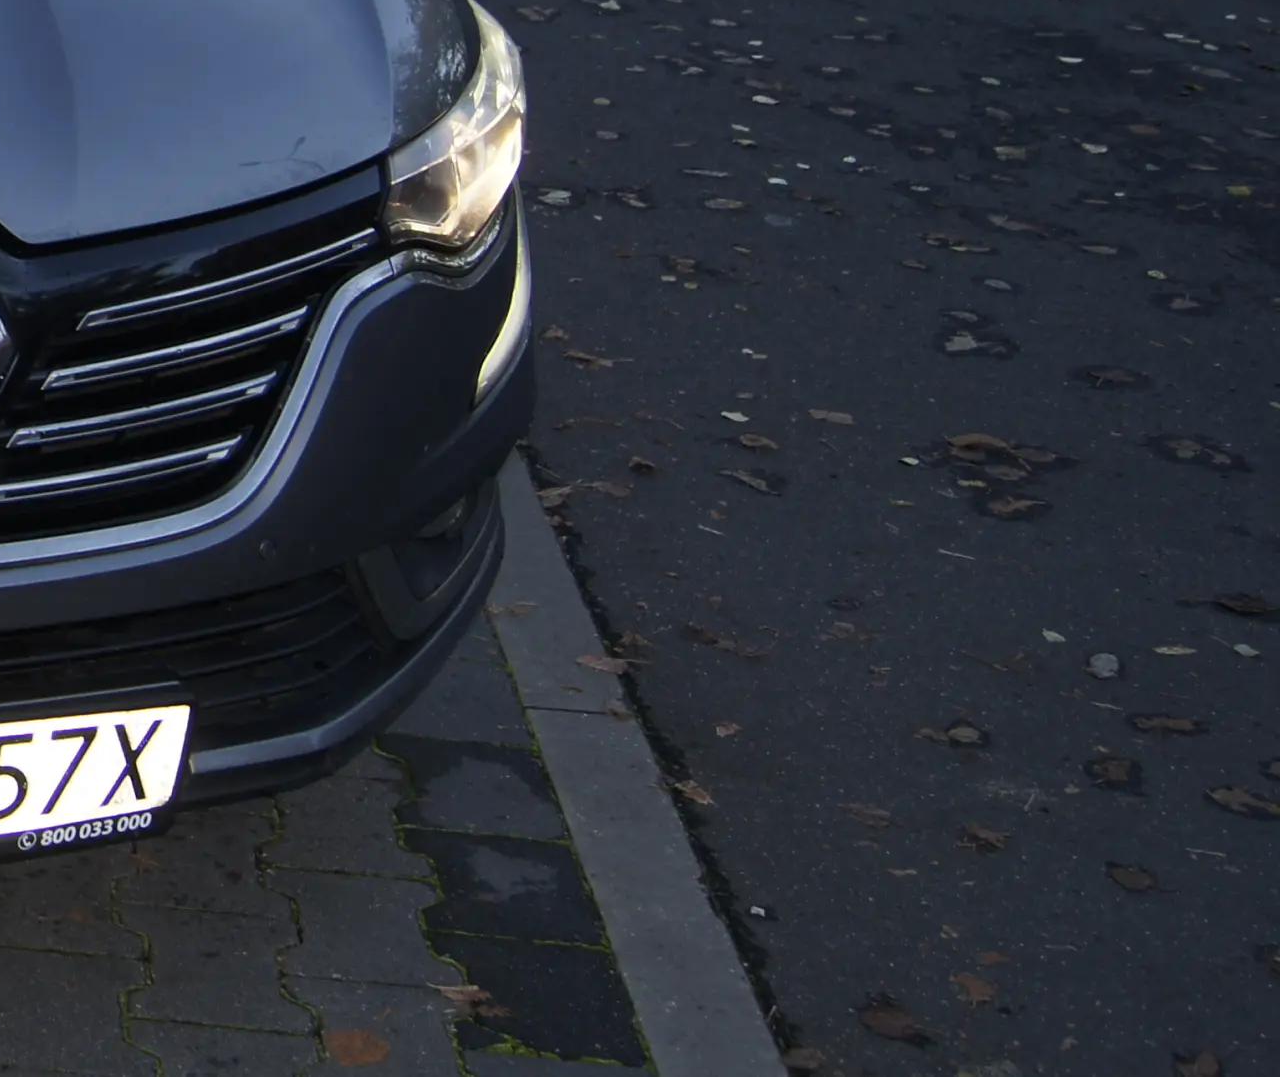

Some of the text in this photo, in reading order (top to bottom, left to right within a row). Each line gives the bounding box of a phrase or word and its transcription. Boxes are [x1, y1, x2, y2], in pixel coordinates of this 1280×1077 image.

[40, 812, 152, 846] 800 033 000
